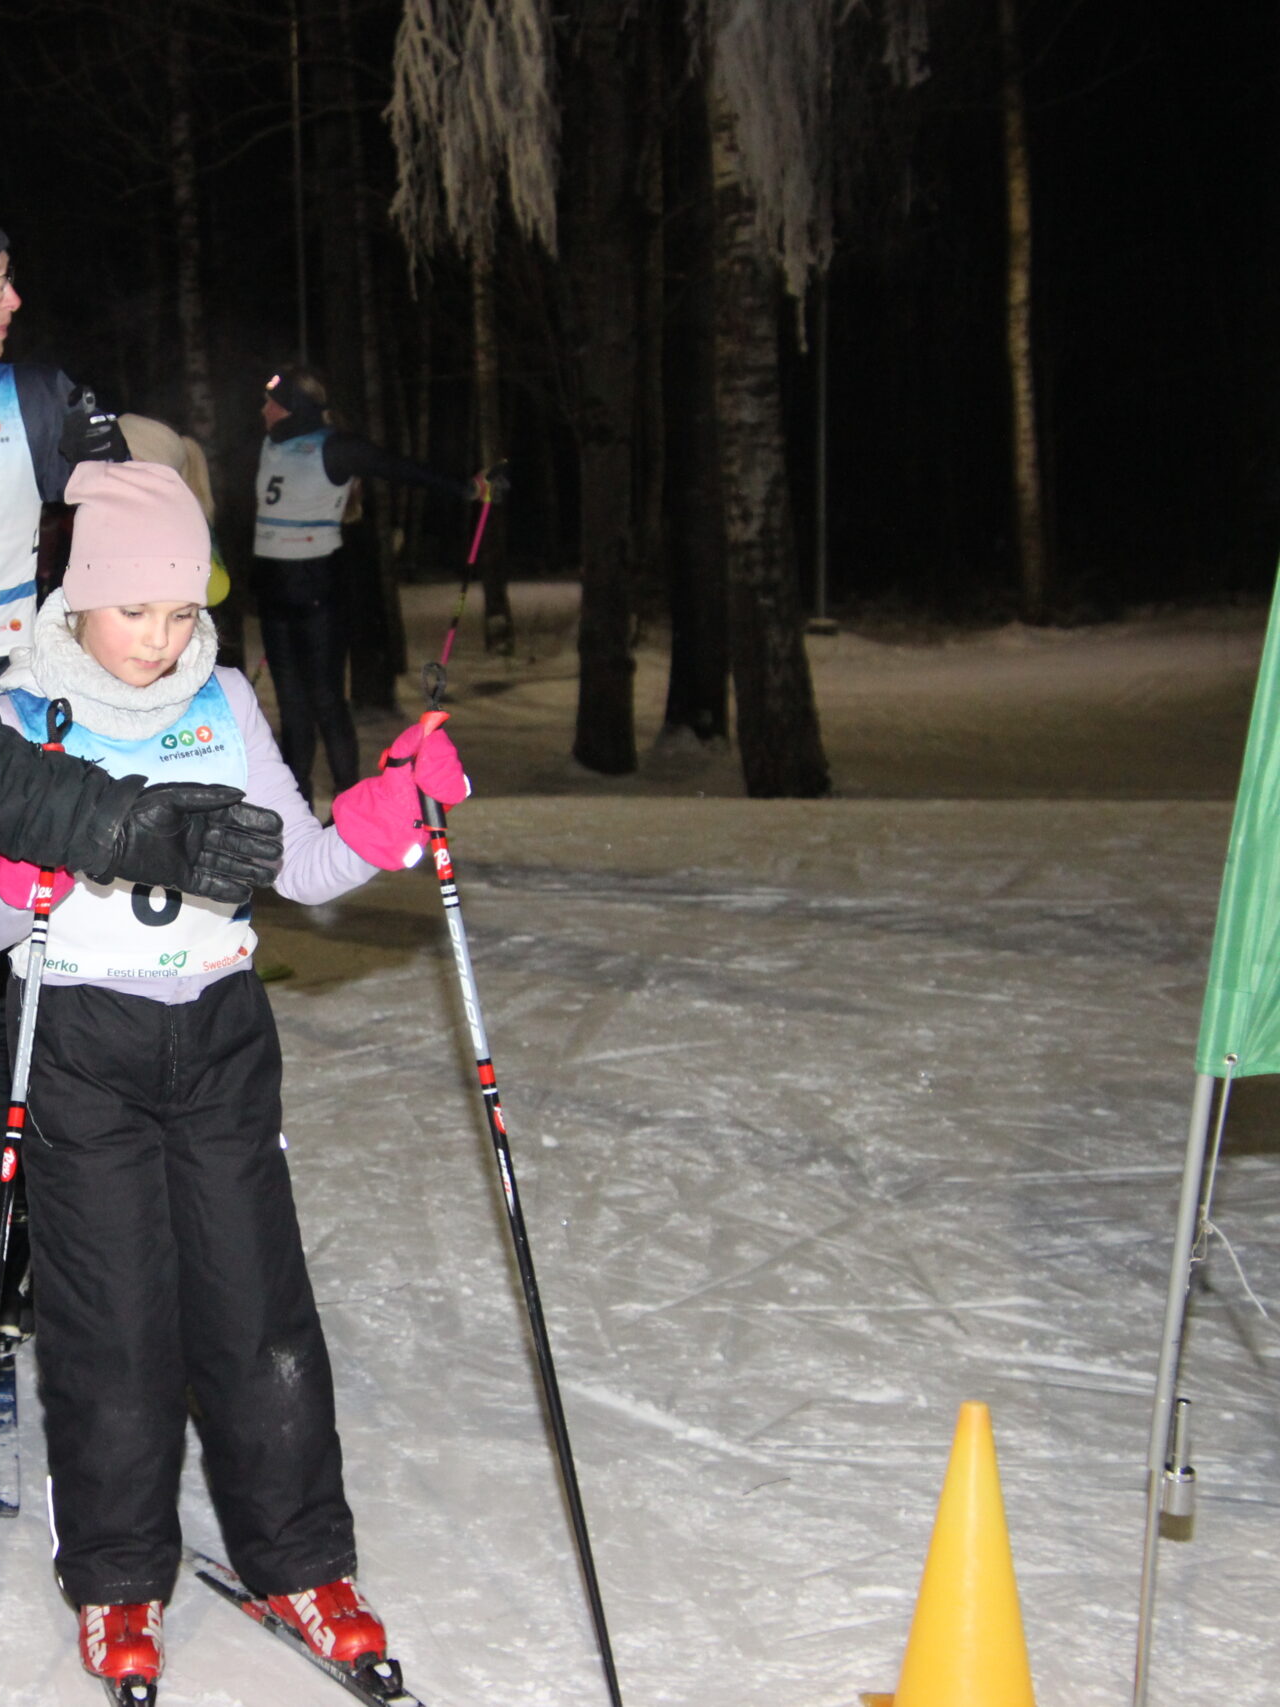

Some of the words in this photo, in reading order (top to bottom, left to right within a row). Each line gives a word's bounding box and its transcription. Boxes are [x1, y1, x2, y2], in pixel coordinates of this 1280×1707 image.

[265, 475, 285, 505] 5
[159, 744, 225, 762] terviserajad.ee
[107, 967, 135, 978] Eesti
[138, 967, 178, 979] Energia
